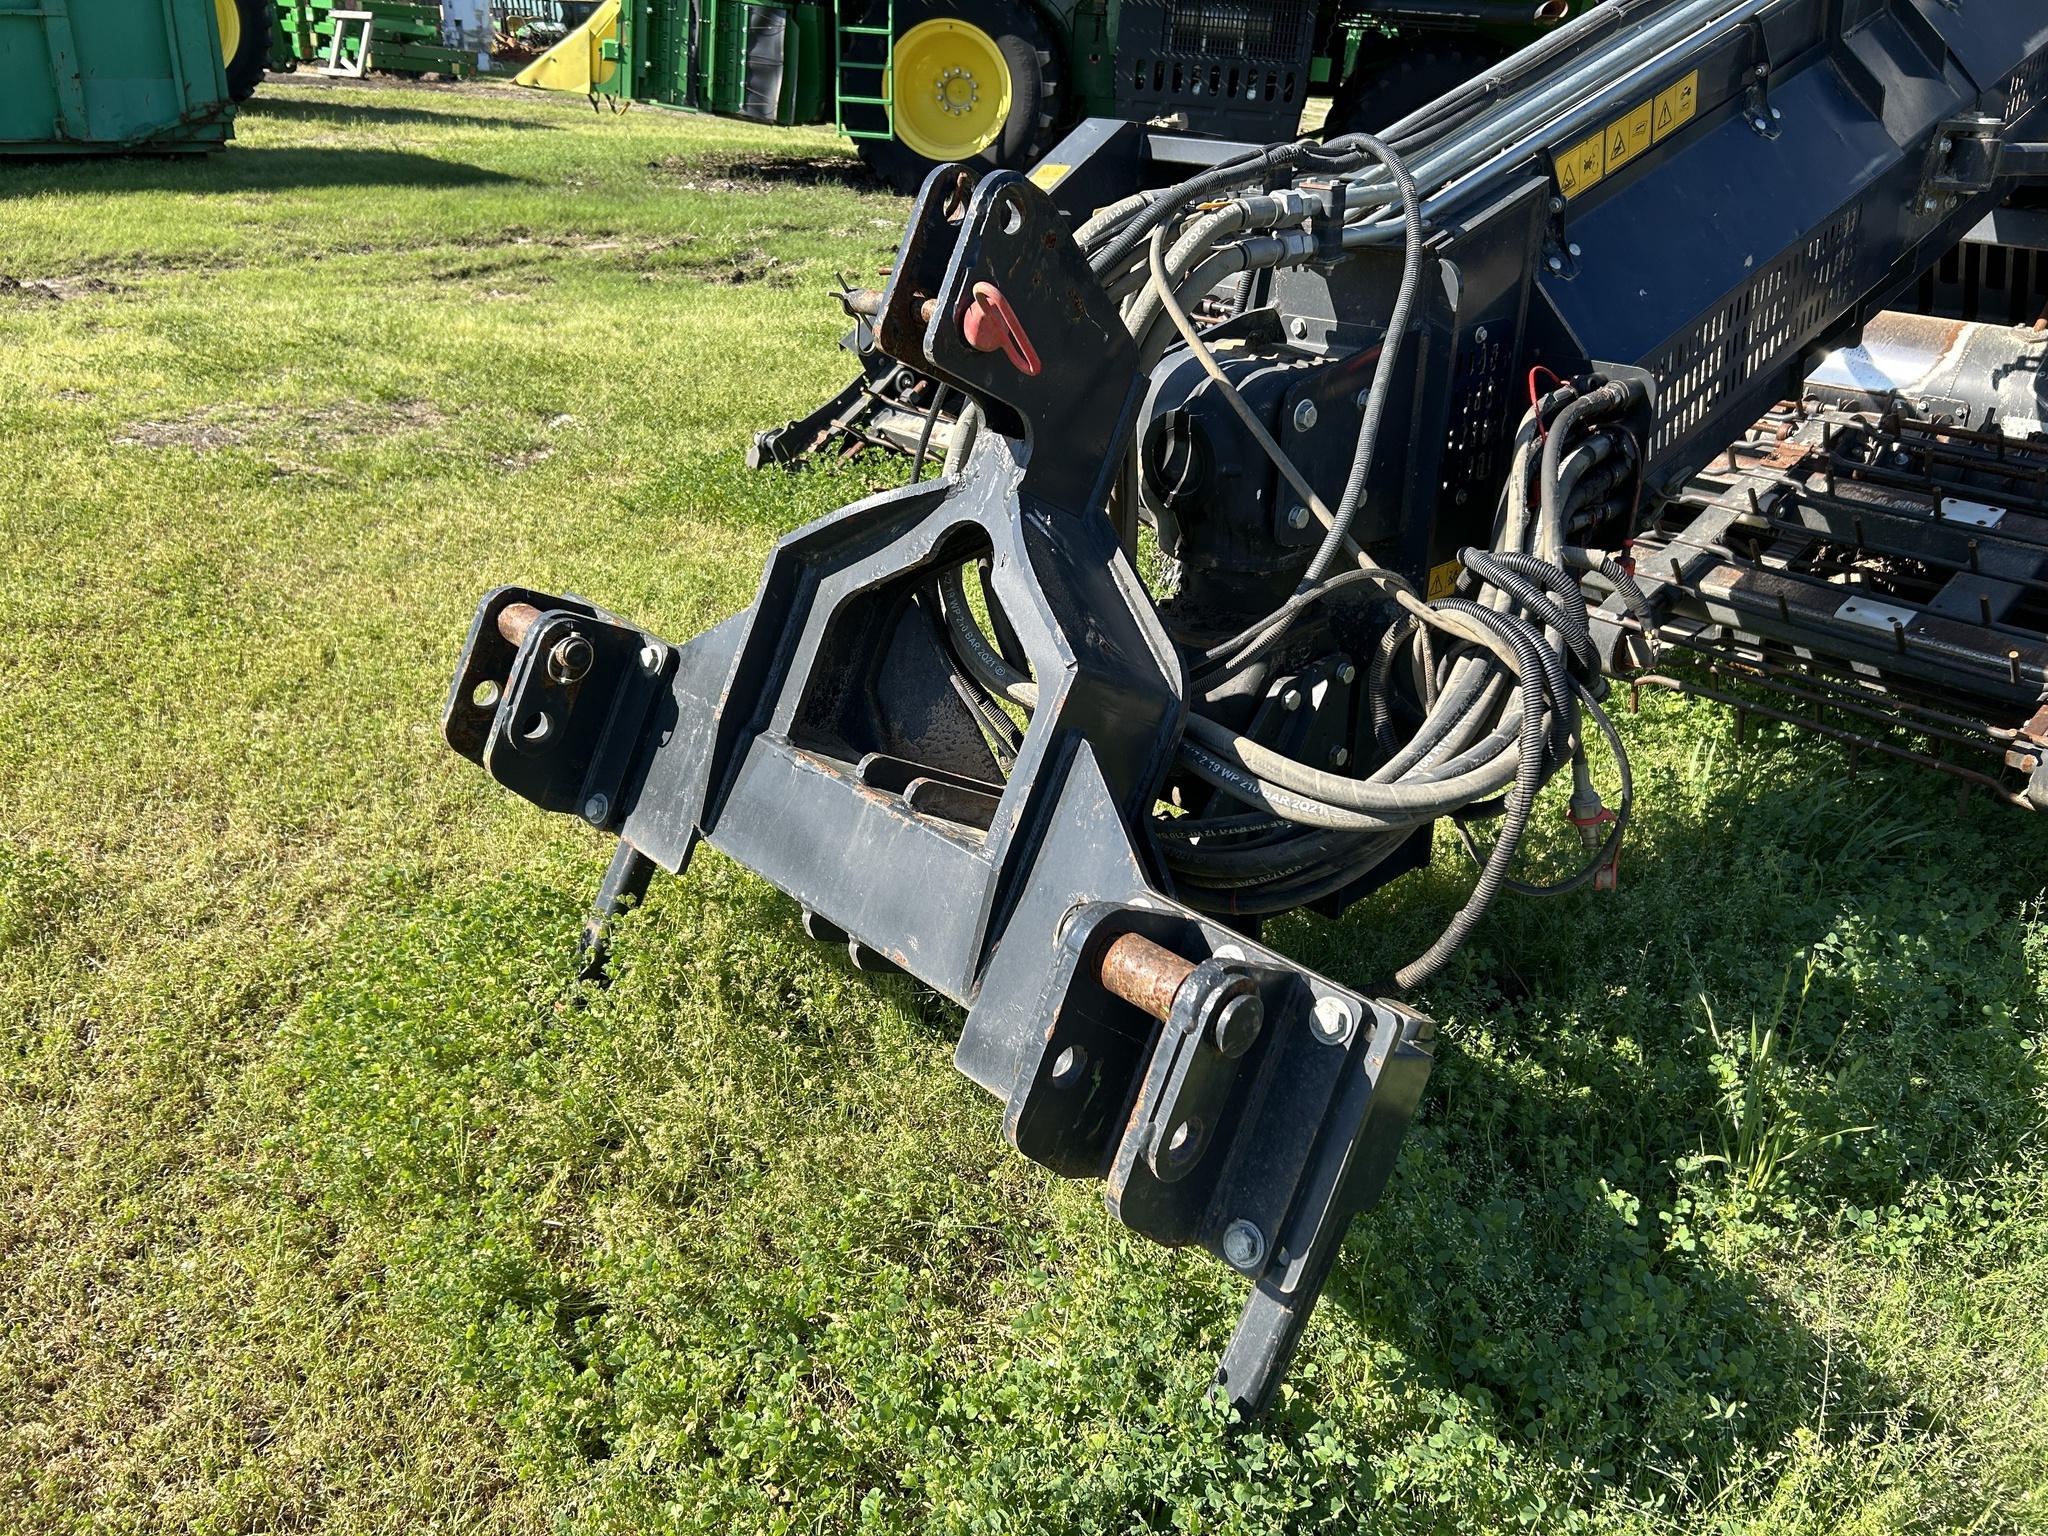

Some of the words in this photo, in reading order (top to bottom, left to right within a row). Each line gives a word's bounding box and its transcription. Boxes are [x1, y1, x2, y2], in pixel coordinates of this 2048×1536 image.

[1182, 228, 1205, 250] 2Q21
[949, 599, 962, 616] WP
[955, 615, 969, 633] 210
[965, 634, 981, 652] BAR
[979, 651, 996, 668] 2Q21
[1209, 760, 1222, 774] 19
[1221, 767, 1240, 783] WP
[1240, 778, 1261, 795] 210
[1262, 787, 1291, 807] BAR
[1290, 797, 1326, 816] 2Q21
